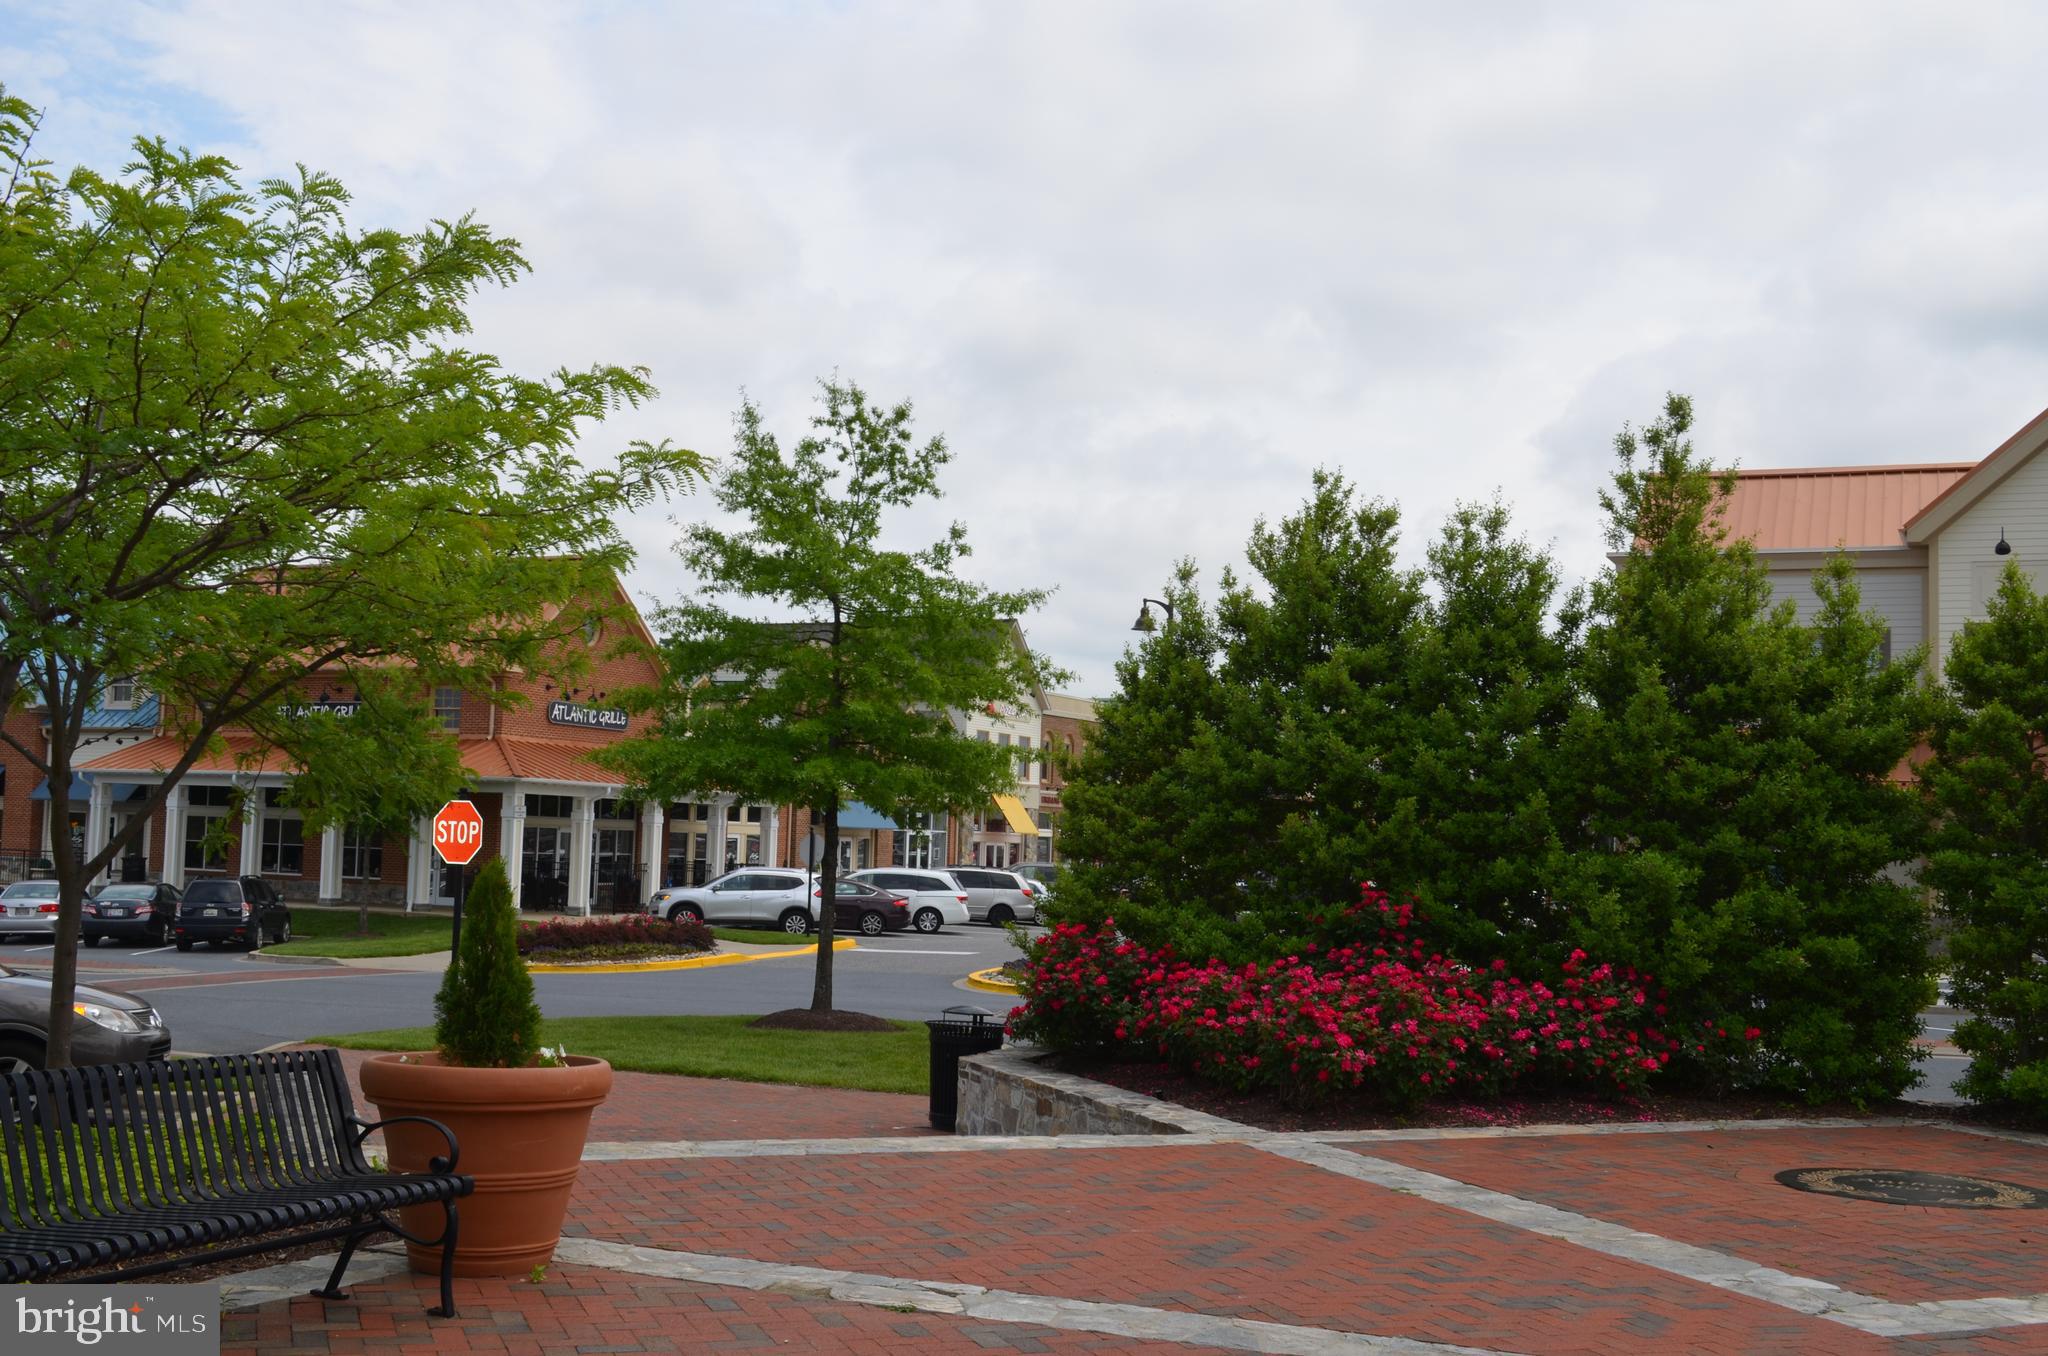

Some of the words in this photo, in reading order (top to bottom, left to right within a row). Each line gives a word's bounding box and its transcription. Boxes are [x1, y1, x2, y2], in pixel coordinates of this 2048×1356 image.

[551, 703, 597, 724] ATLANTIC
[598, 710, 627, 726] GRILLE
[437, 820, 479, 844] STOP
